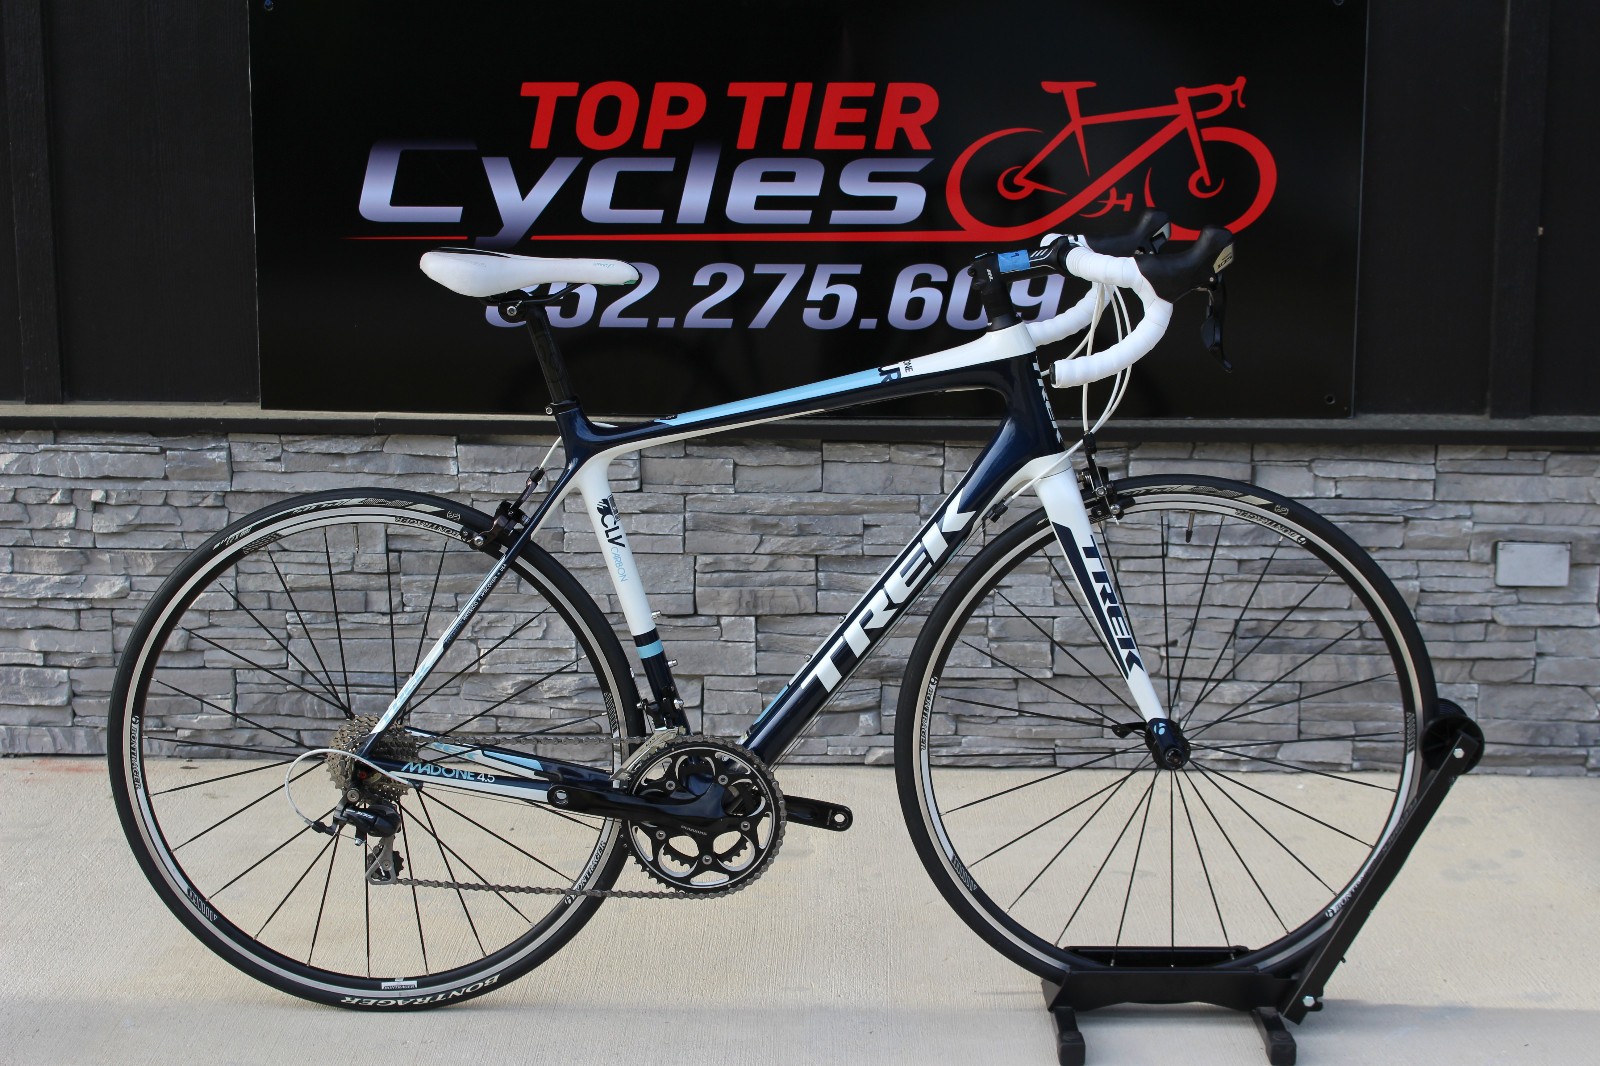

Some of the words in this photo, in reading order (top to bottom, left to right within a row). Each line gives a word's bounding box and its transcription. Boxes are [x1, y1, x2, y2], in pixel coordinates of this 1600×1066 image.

[520, 81, 707, 150] TOP
[727, 82, 939, 150] TIER
[358, 138, 934, 247] Cycles
[611, 546, 627, 583] CARBON
[800, 487, 976, 693] TREK
[1079, 533, 1145, 672] TREK
[401, 761, 475, 781] MADONE
[477, 772, 496, 783] 4.5
[572, 840, 606, 896] ONTRAGER
[340, 973, 501, 1007] BONTRAGER
